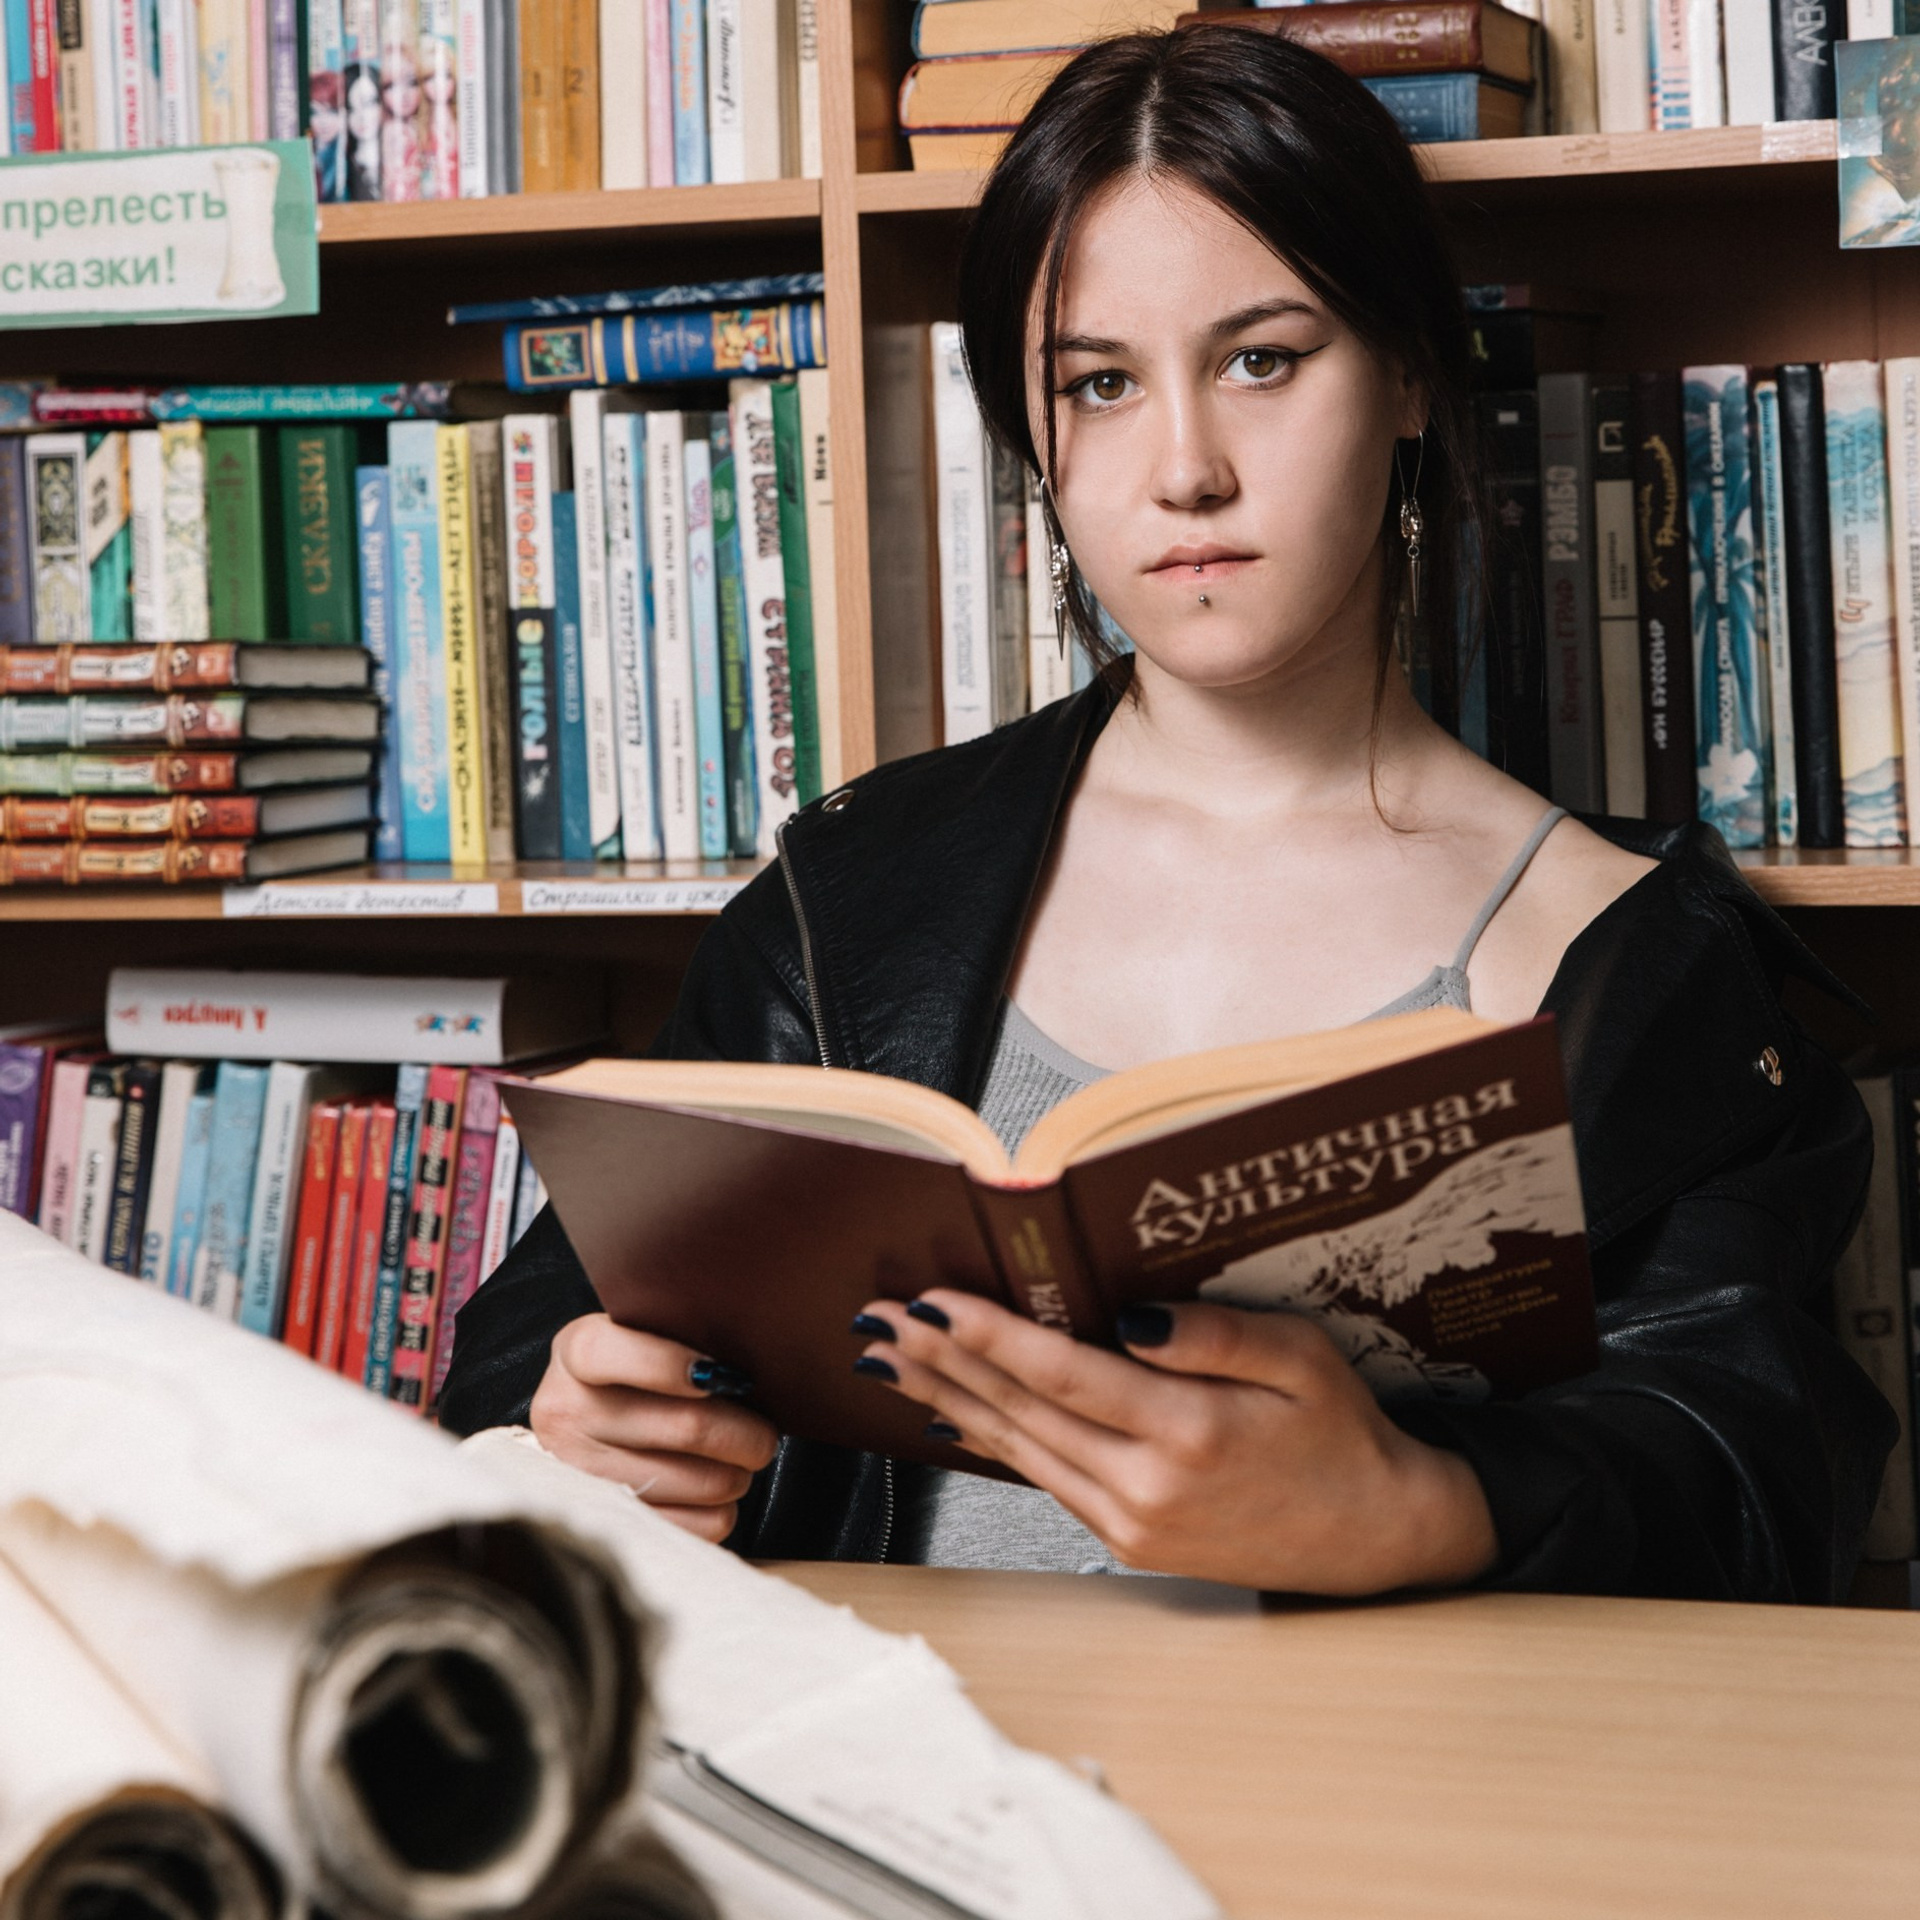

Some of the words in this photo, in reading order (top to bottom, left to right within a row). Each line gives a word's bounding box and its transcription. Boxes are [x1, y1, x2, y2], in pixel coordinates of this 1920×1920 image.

[568, 68, 584, 94] 2
[3, 190, 228, 238] прелесть
[2, 246, 177, 292] сказки!
[1708, 400, 1726, 473] ОКЕАНИИ
[1841, 423, 1860, 527] ТАНКИСТА
[1860, 422, 1880, 500] СОБАКА
[299, 437, 332, 597] СКАЗКИ
[1547, 464, 1579, 562] РЭМБО
[516, 618, 548, 762] ГОЛЫЕ
[762, 597, 793, 740] СТРАНА
[251, 888, 349, 917] Детский
[356, 886, 467, 910] детектив
[529, 887, 657, 914] Страшилки
[664, 891, 680, 904] и
[1129, 1077, 1519, 1226] Античная
[1136, 1122, 1480, 1252] культура
